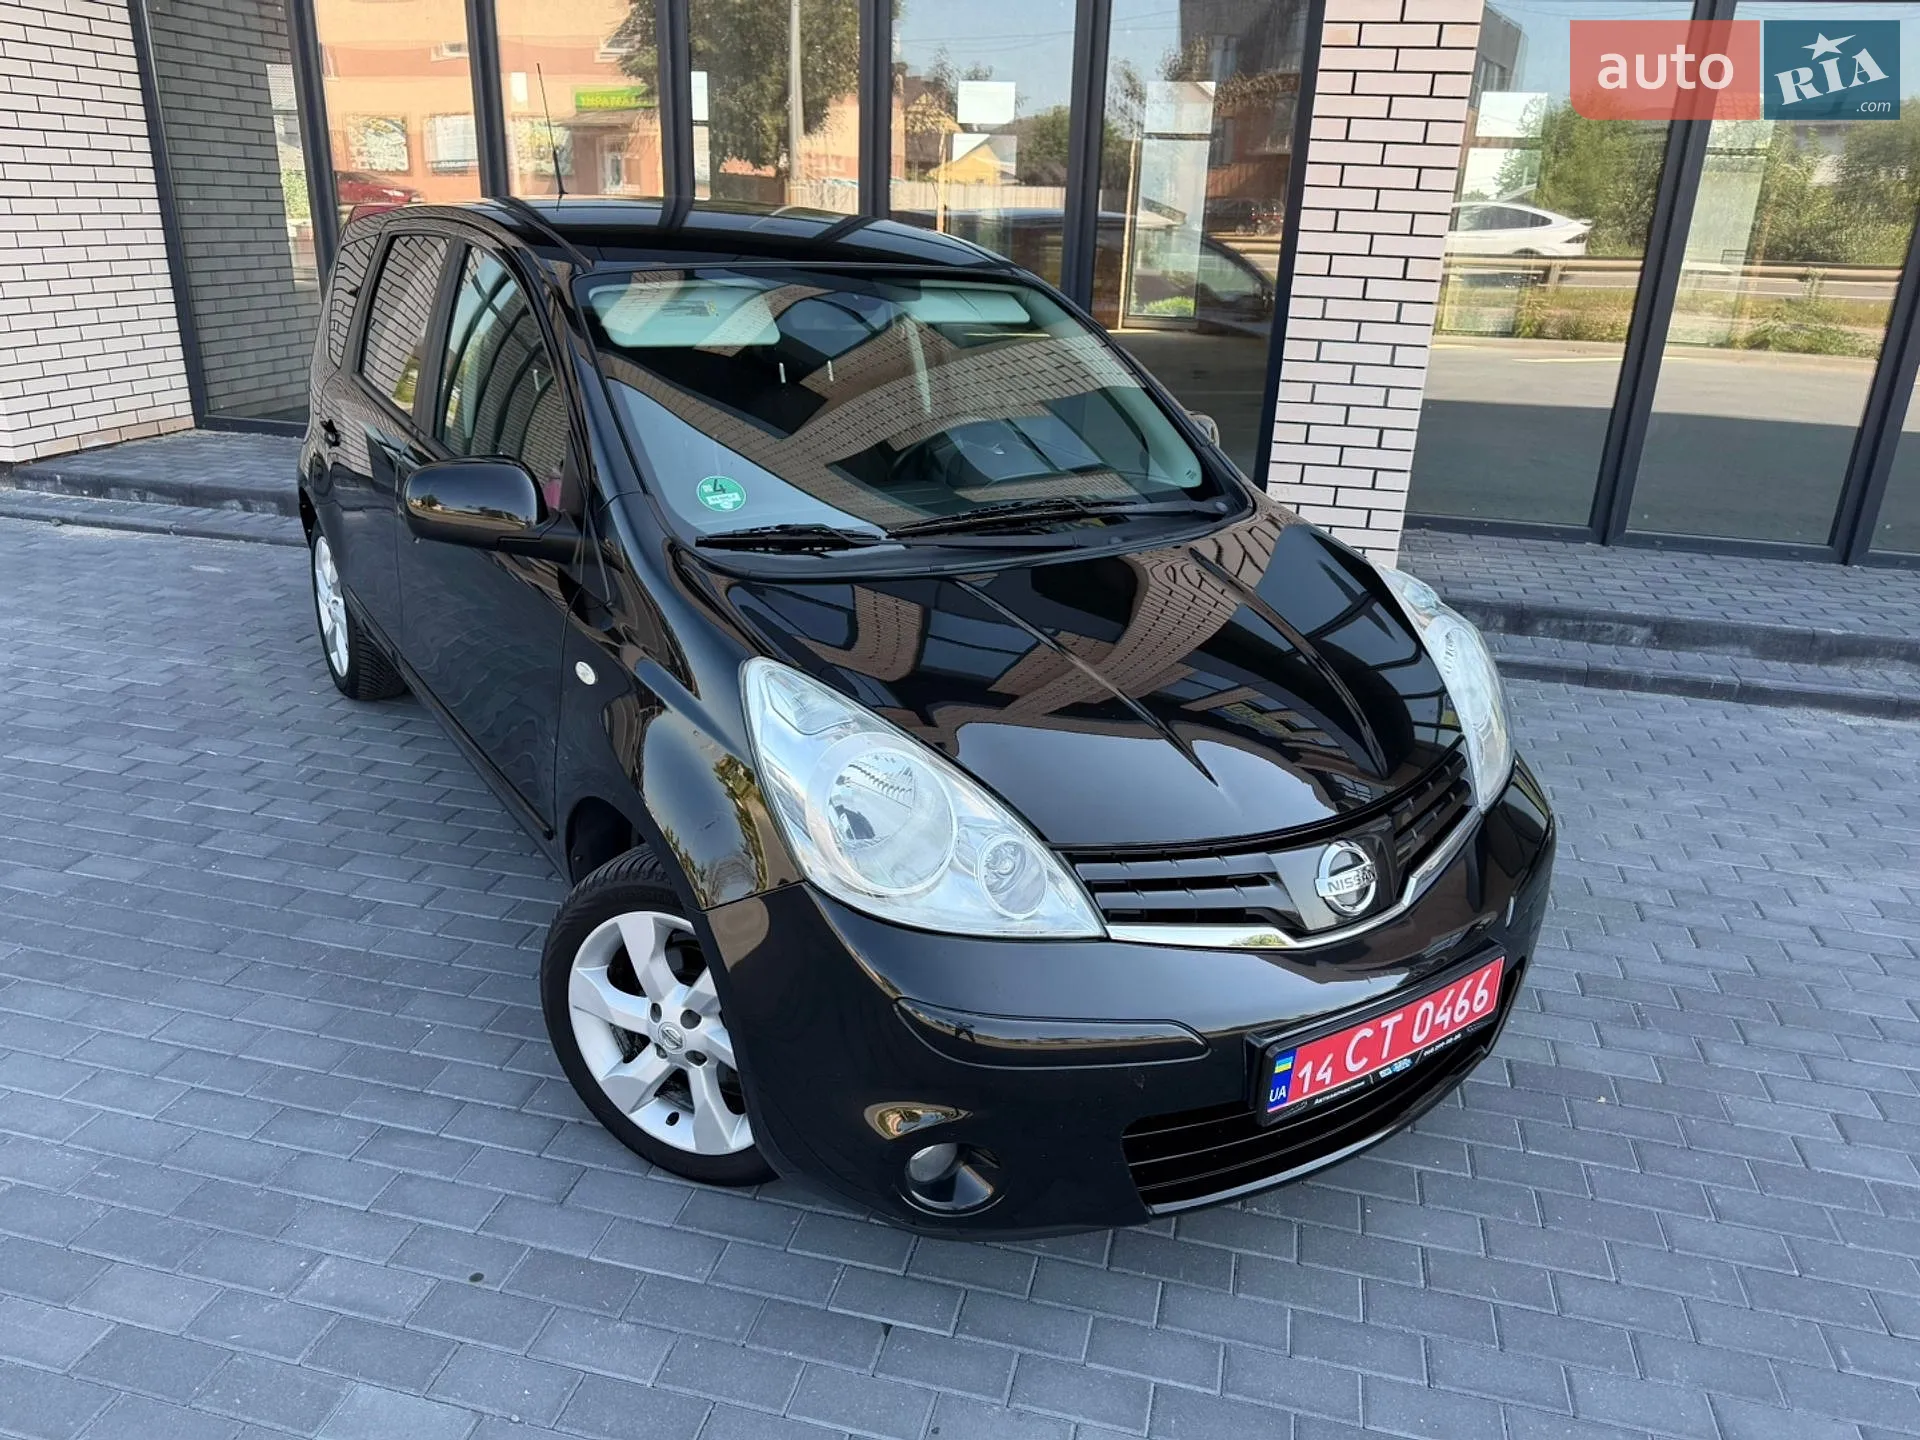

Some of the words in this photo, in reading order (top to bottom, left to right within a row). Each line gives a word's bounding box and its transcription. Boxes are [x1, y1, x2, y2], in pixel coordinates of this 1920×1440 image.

[713, 479, 726, 494] 4
[1327, 868, 1375, 893] NISSAN
[1298, 1053, 1333, 1093] 14
[1345, 1013, 1402, 1072] CT
[1412, 968, 1492, 1044] 0466
[1269, 1085, 1287, 1102] UA
